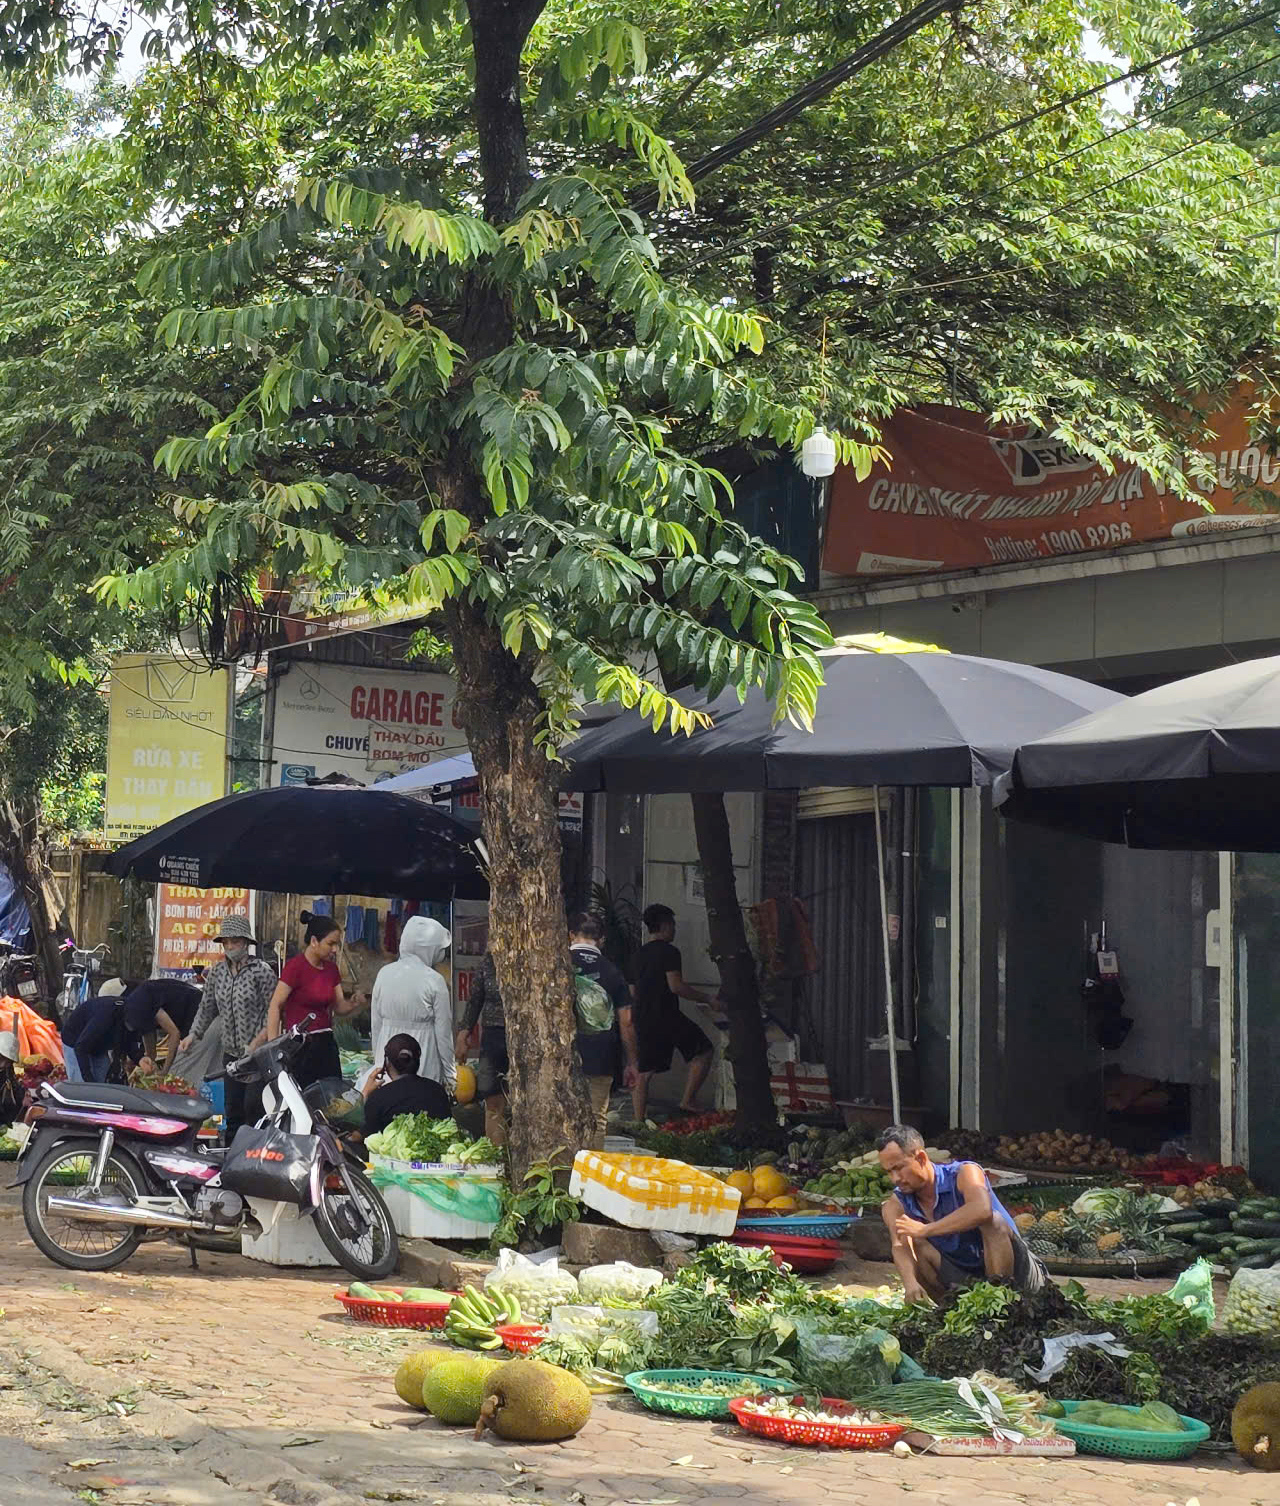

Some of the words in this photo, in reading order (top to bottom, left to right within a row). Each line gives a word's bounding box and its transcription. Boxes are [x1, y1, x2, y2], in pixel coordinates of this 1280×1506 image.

[984, 536, 1039, 561] Hotline:
[1040, 528, 1086, 556] 1900
[350, 685, 445, 728] GARAGE
[325, 733, 369, 753] CHUYÊ
[373, 730, 410, 745] THAY
[178, 749, 202, 770] XE
[167, 885, 207, 898] THAY
